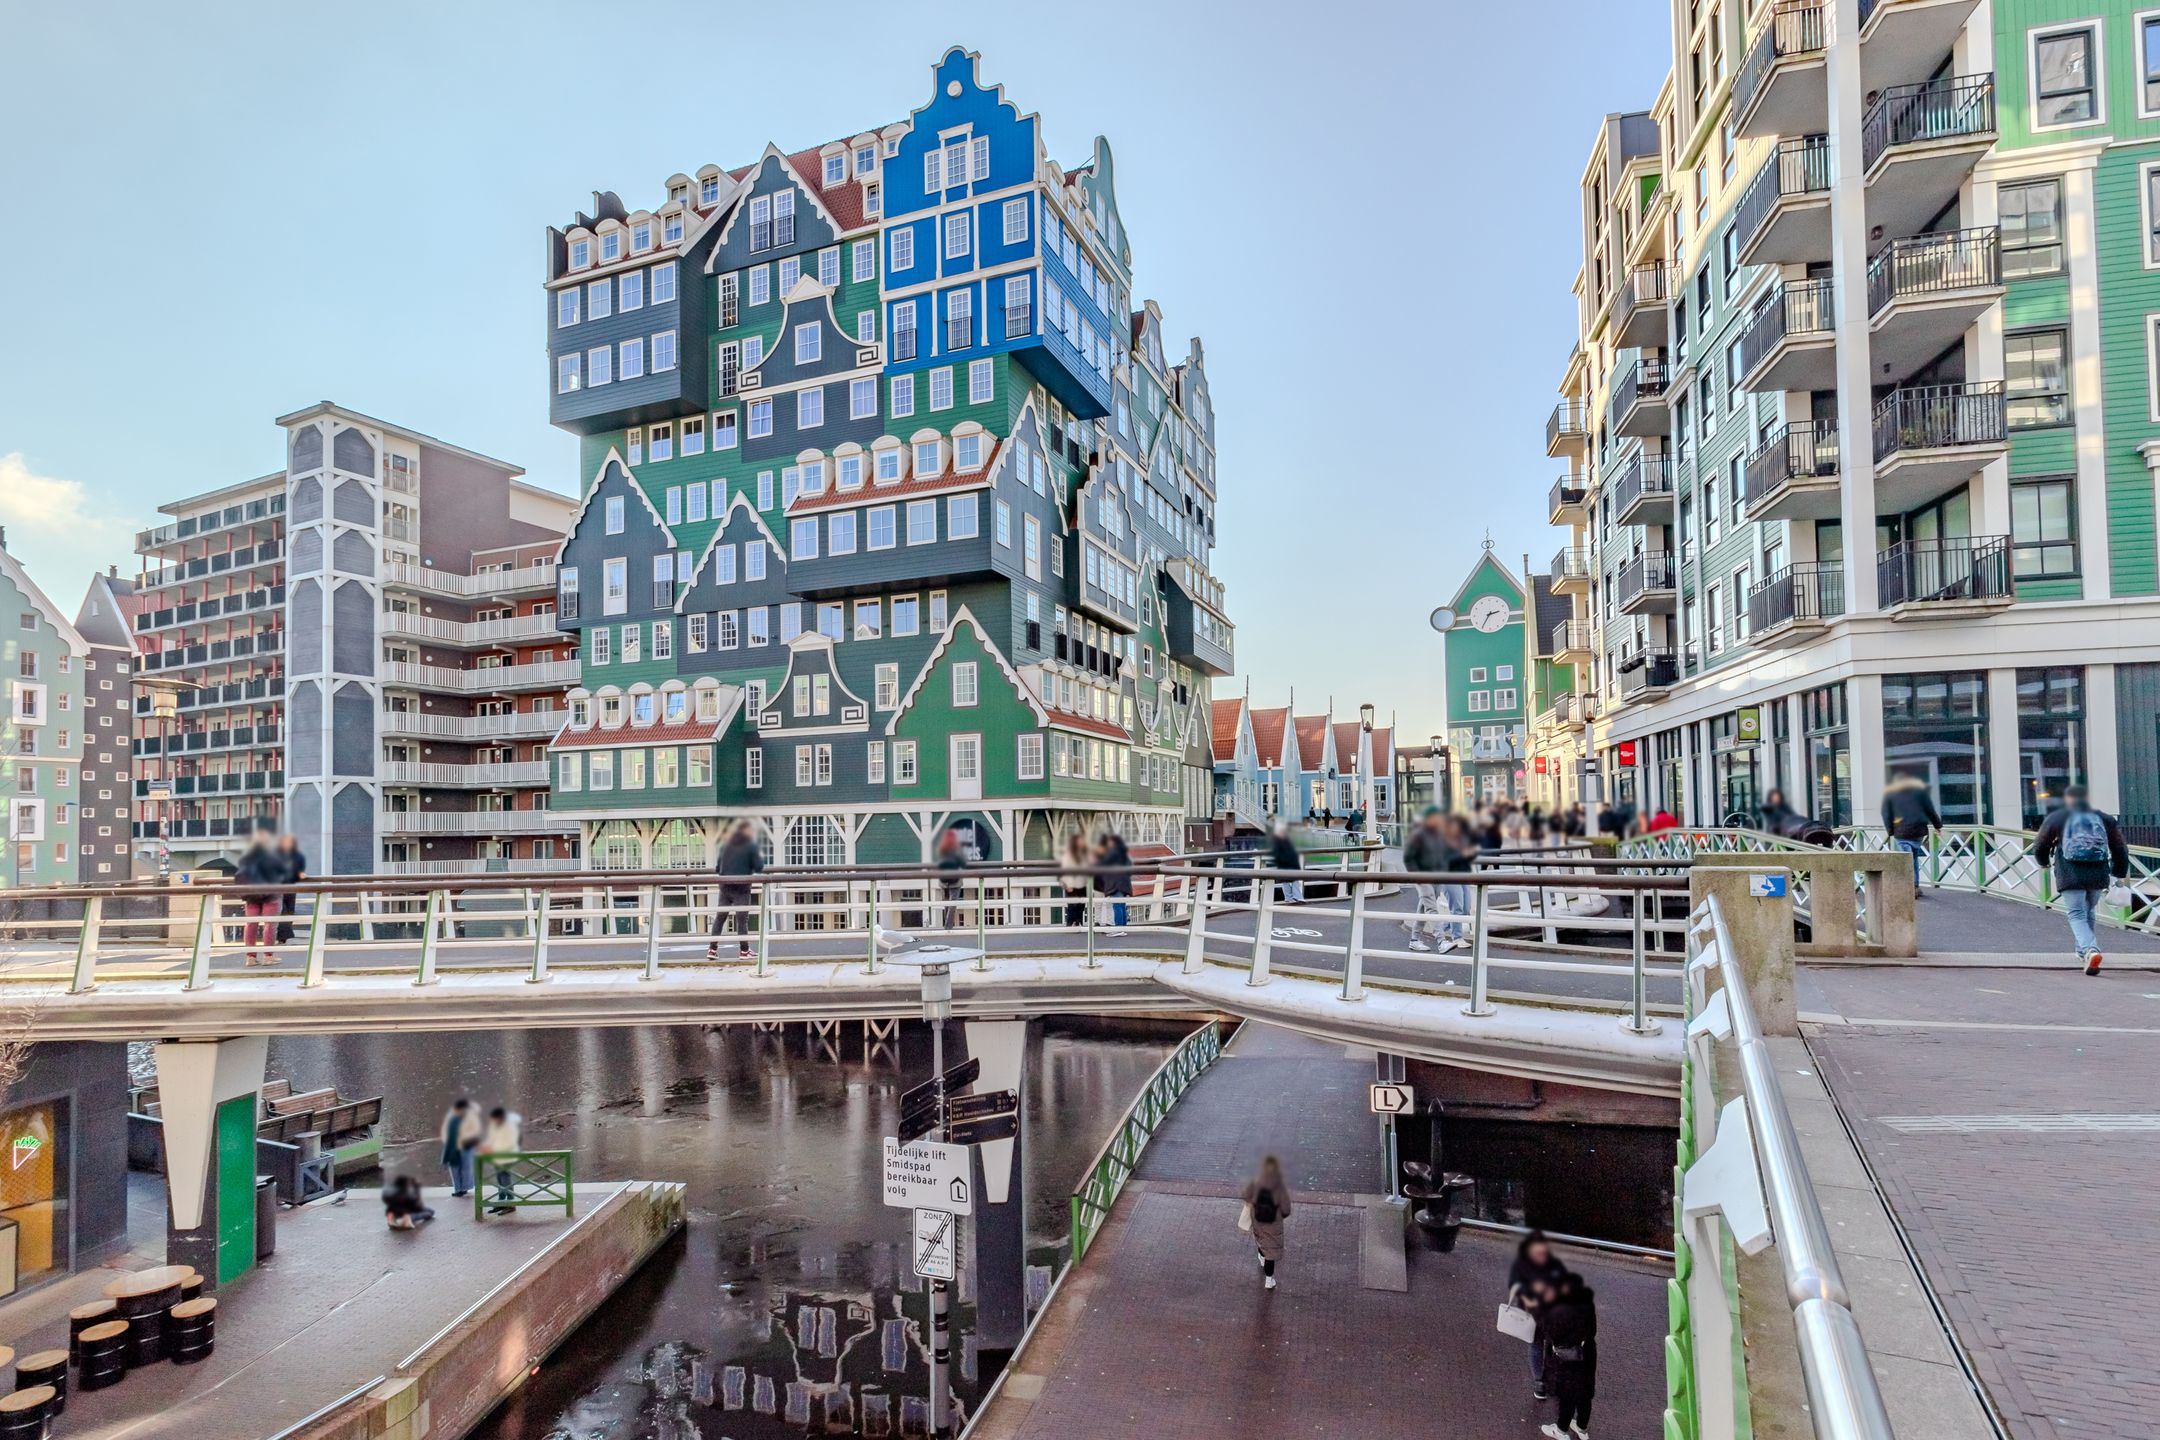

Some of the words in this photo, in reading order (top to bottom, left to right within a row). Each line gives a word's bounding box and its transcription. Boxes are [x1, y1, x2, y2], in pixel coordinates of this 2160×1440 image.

[1383, 1090, 1393, 1106] L
[886, 1145, 929, 1160] Tijdelijke
[932, 1150, 947, 1160] lift
[886, 1158, 931, 1173] Smidspad
[887, 1171, 937, 1186] bereikbaar
[887, 1185, 907, 1197] volg
[956, 1185, 964, 1199] L
[923, 1212, 944, 1221] ZONE
